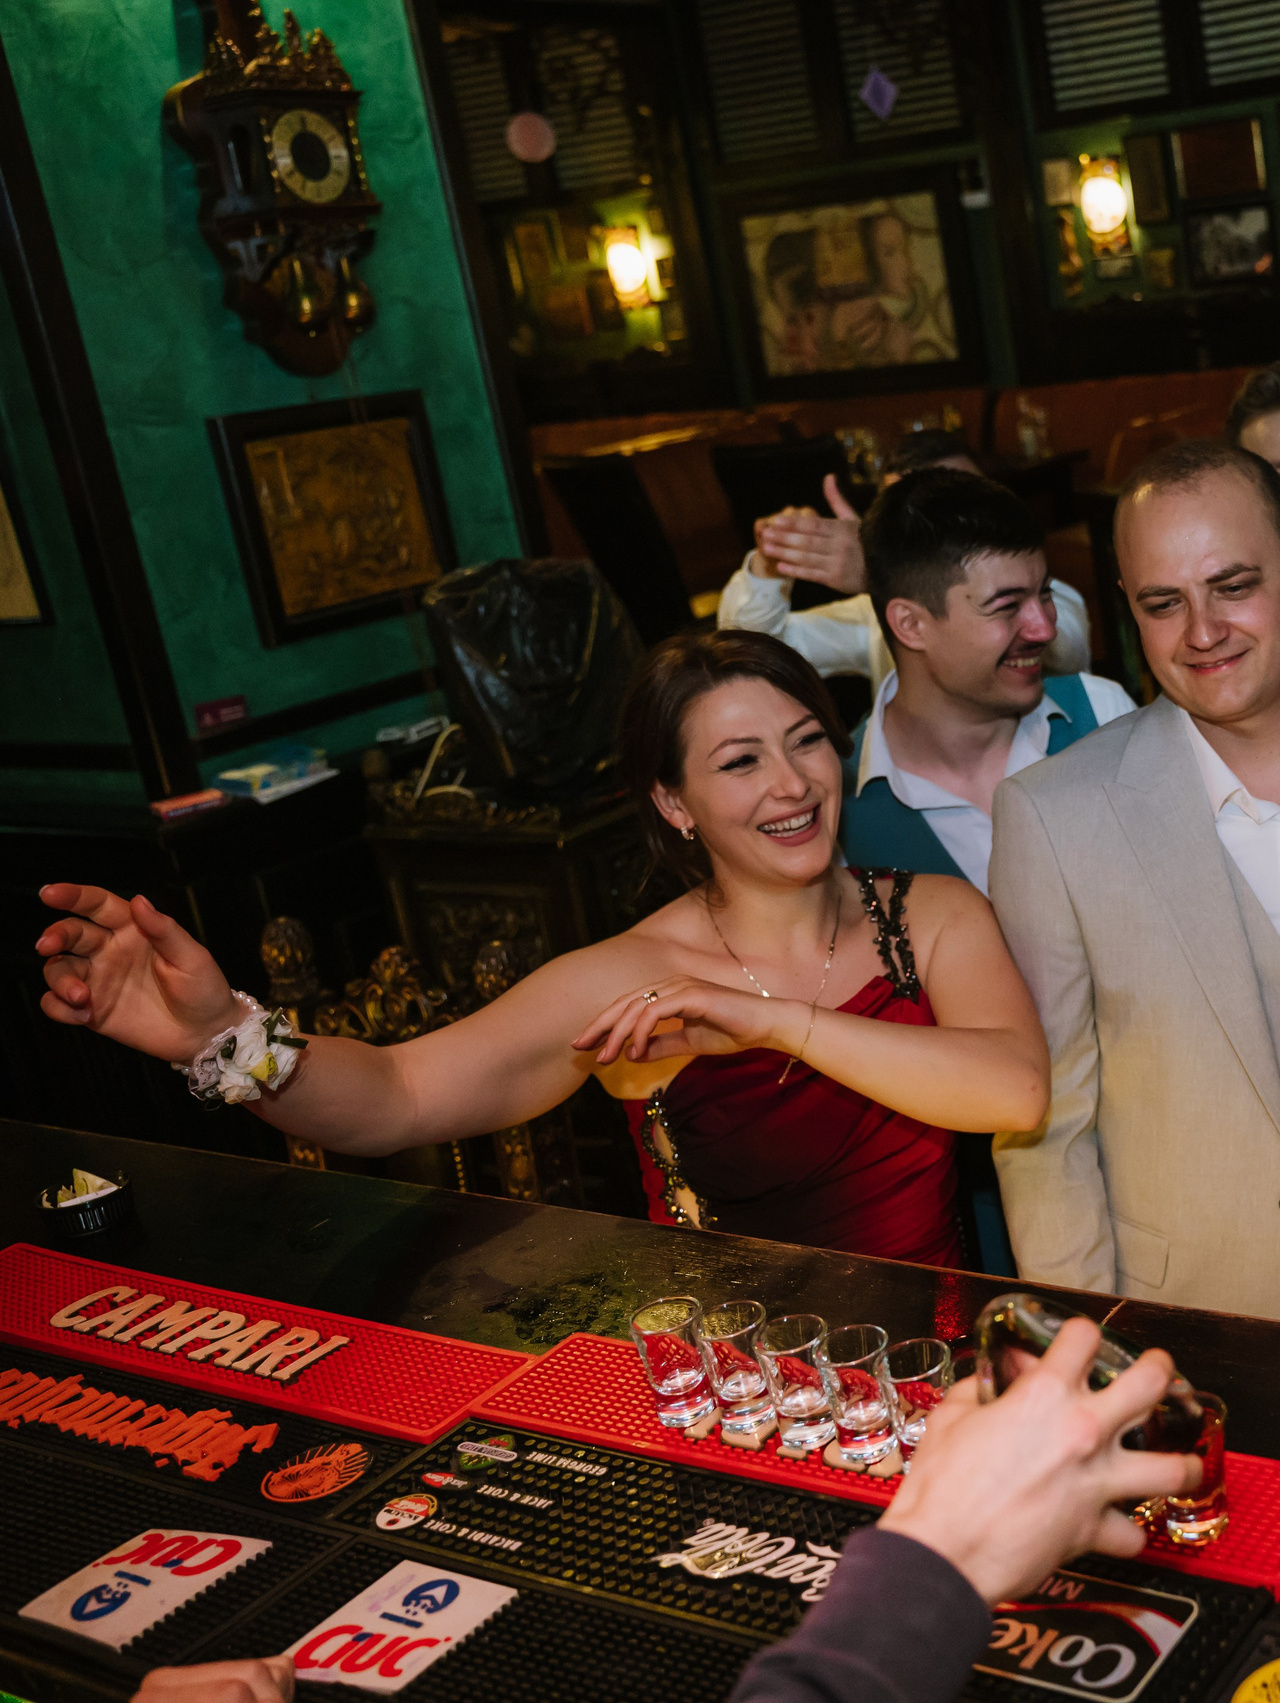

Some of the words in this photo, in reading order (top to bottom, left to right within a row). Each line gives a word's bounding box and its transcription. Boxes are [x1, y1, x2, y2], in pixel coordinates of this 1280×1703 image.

[49, 1285, 351, 1381] CAMPARI
[525, 1451, 557, 1464] LIME
[554, 1457, 610, 1476] GEORGIA
[476, 1484, 509, 1499] COKE
[509, 1493, 521, 1502] &
[520, 1494, 556, 1509] JACK
[422, 1519, 457, 1534] COKE
[457, 1527, 469, 1537] &
[467, 1530, 523, 1551] BACARDI
[988, 1617, 1137, 1689] Coke
